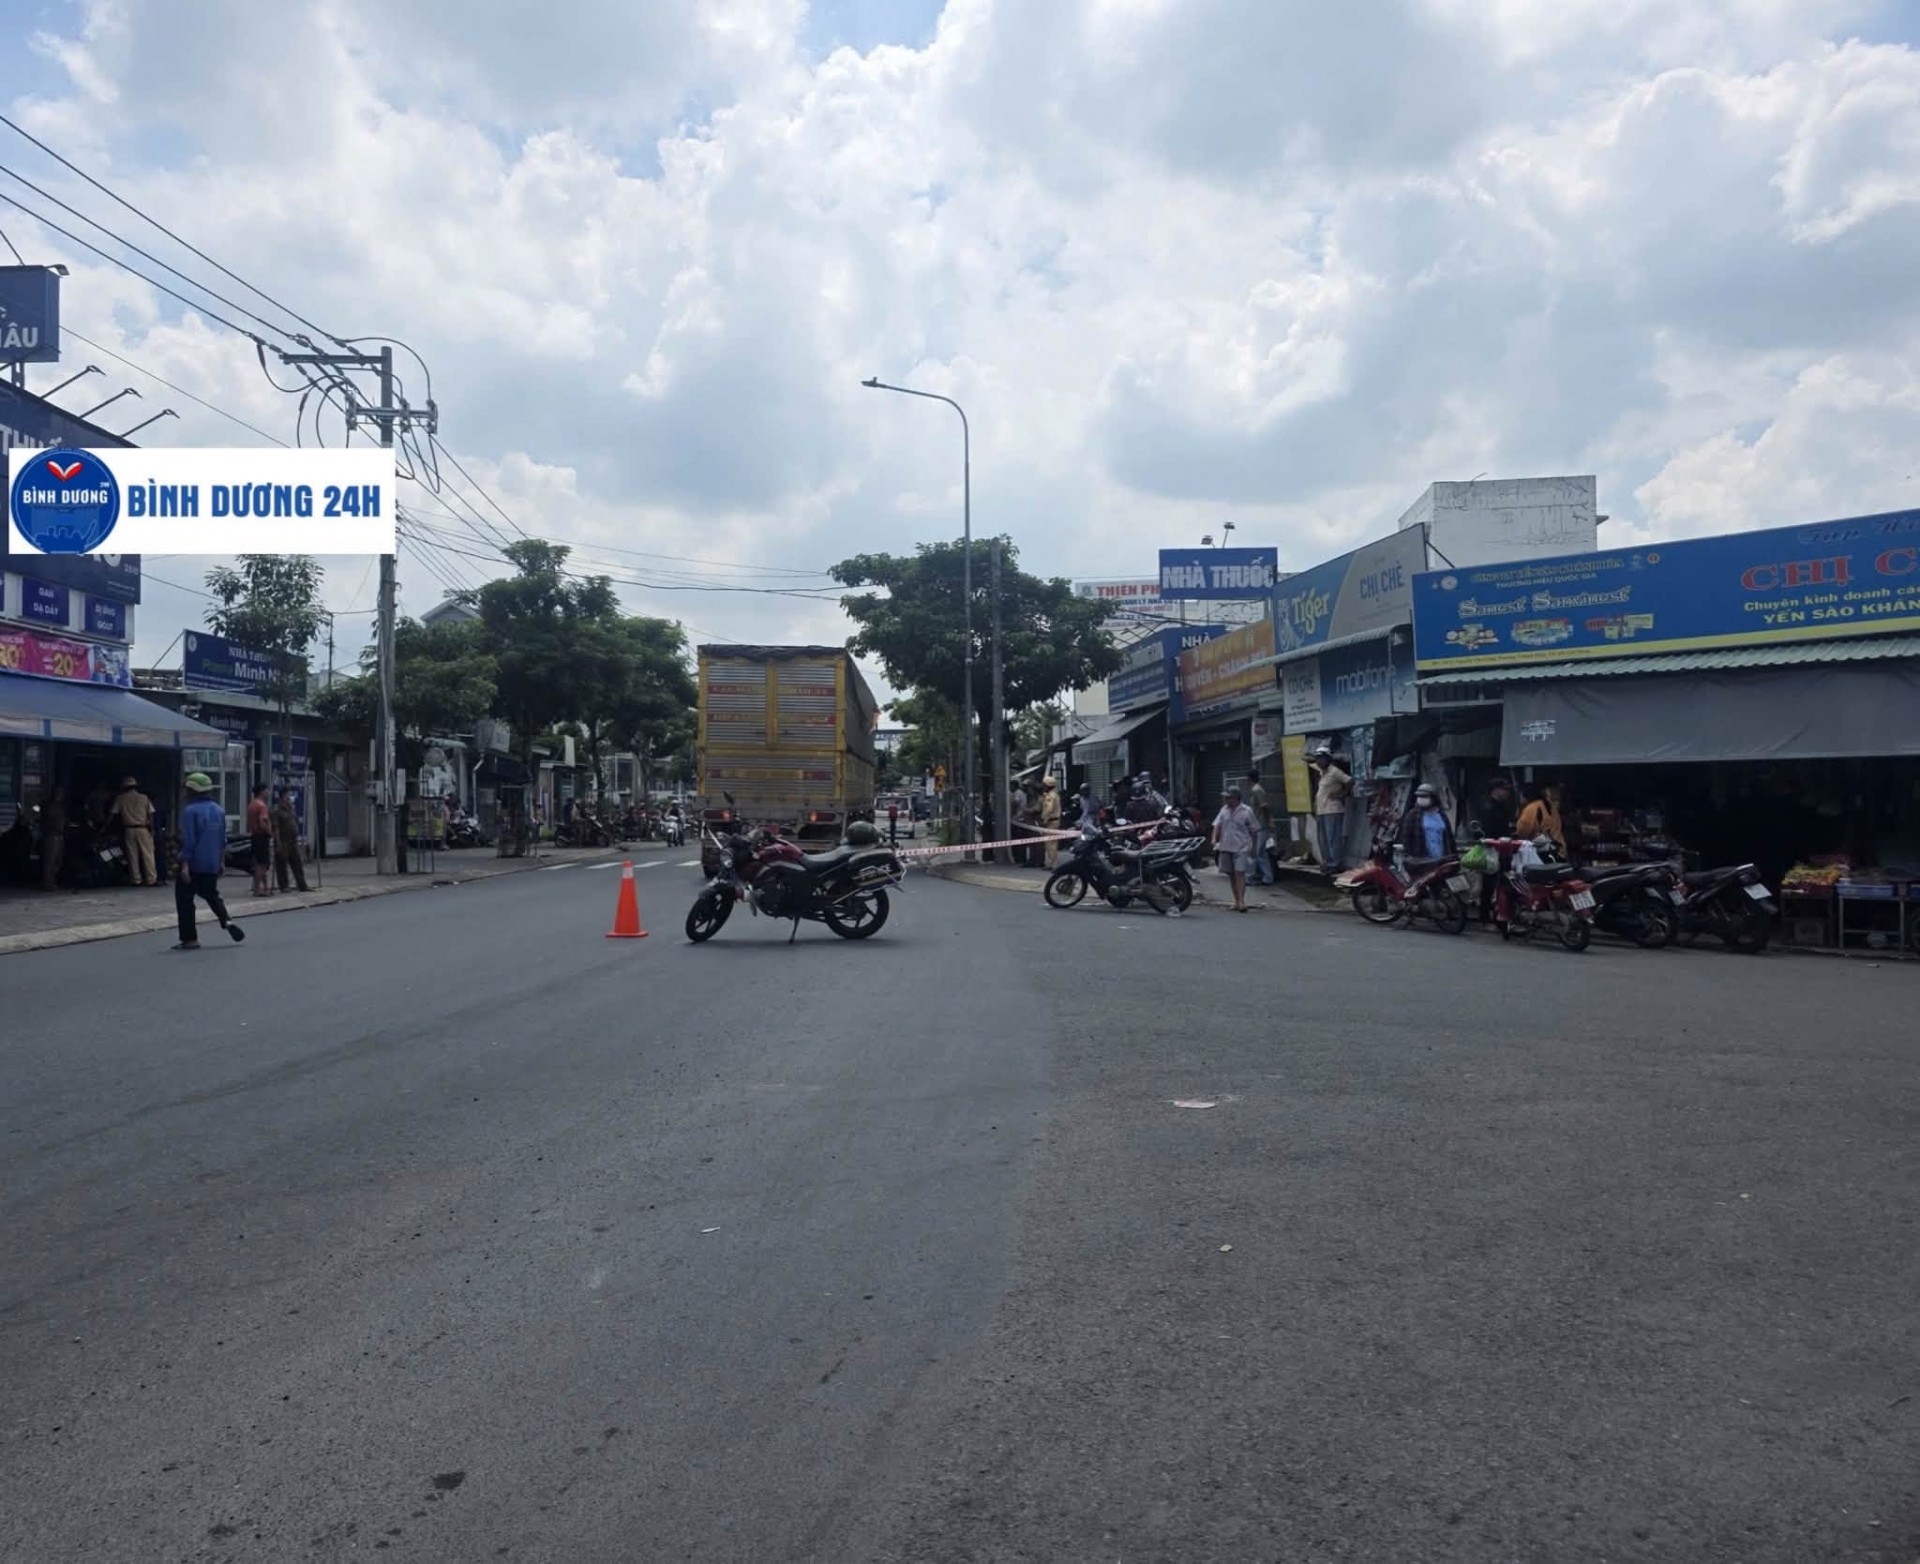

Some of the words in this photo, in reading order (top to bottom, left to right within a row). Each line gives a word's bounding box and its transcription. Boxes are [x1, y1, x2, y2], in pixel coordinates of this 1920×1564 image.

[0, 321, 38, 348] ÂU
[1162, 560, 1206, 589] NHÀ
[1209, 556, 1274, 589] THUỐC
[1360, 573, 1378, 602] CHỊ
[1380, 559, 1405, 593] CHÈ
[1741, 557, 1853, 592] CHỊ
[1291, 587, 1330, 634] Tiger
[1744, 597, 1799, 612] Chuyên
[1804, 593, 1838, 605] kinh
[1843, 588, 1891, 602] doanh
[1763, 608, 1805, 624] YẾN
[1812, 605, 1855, 619] SÀO
[1862, 598, 1920, 614] KHÁN
[1181, 632, 1211, 648] NHÀ
[234, 661, 266, 680] Minh
